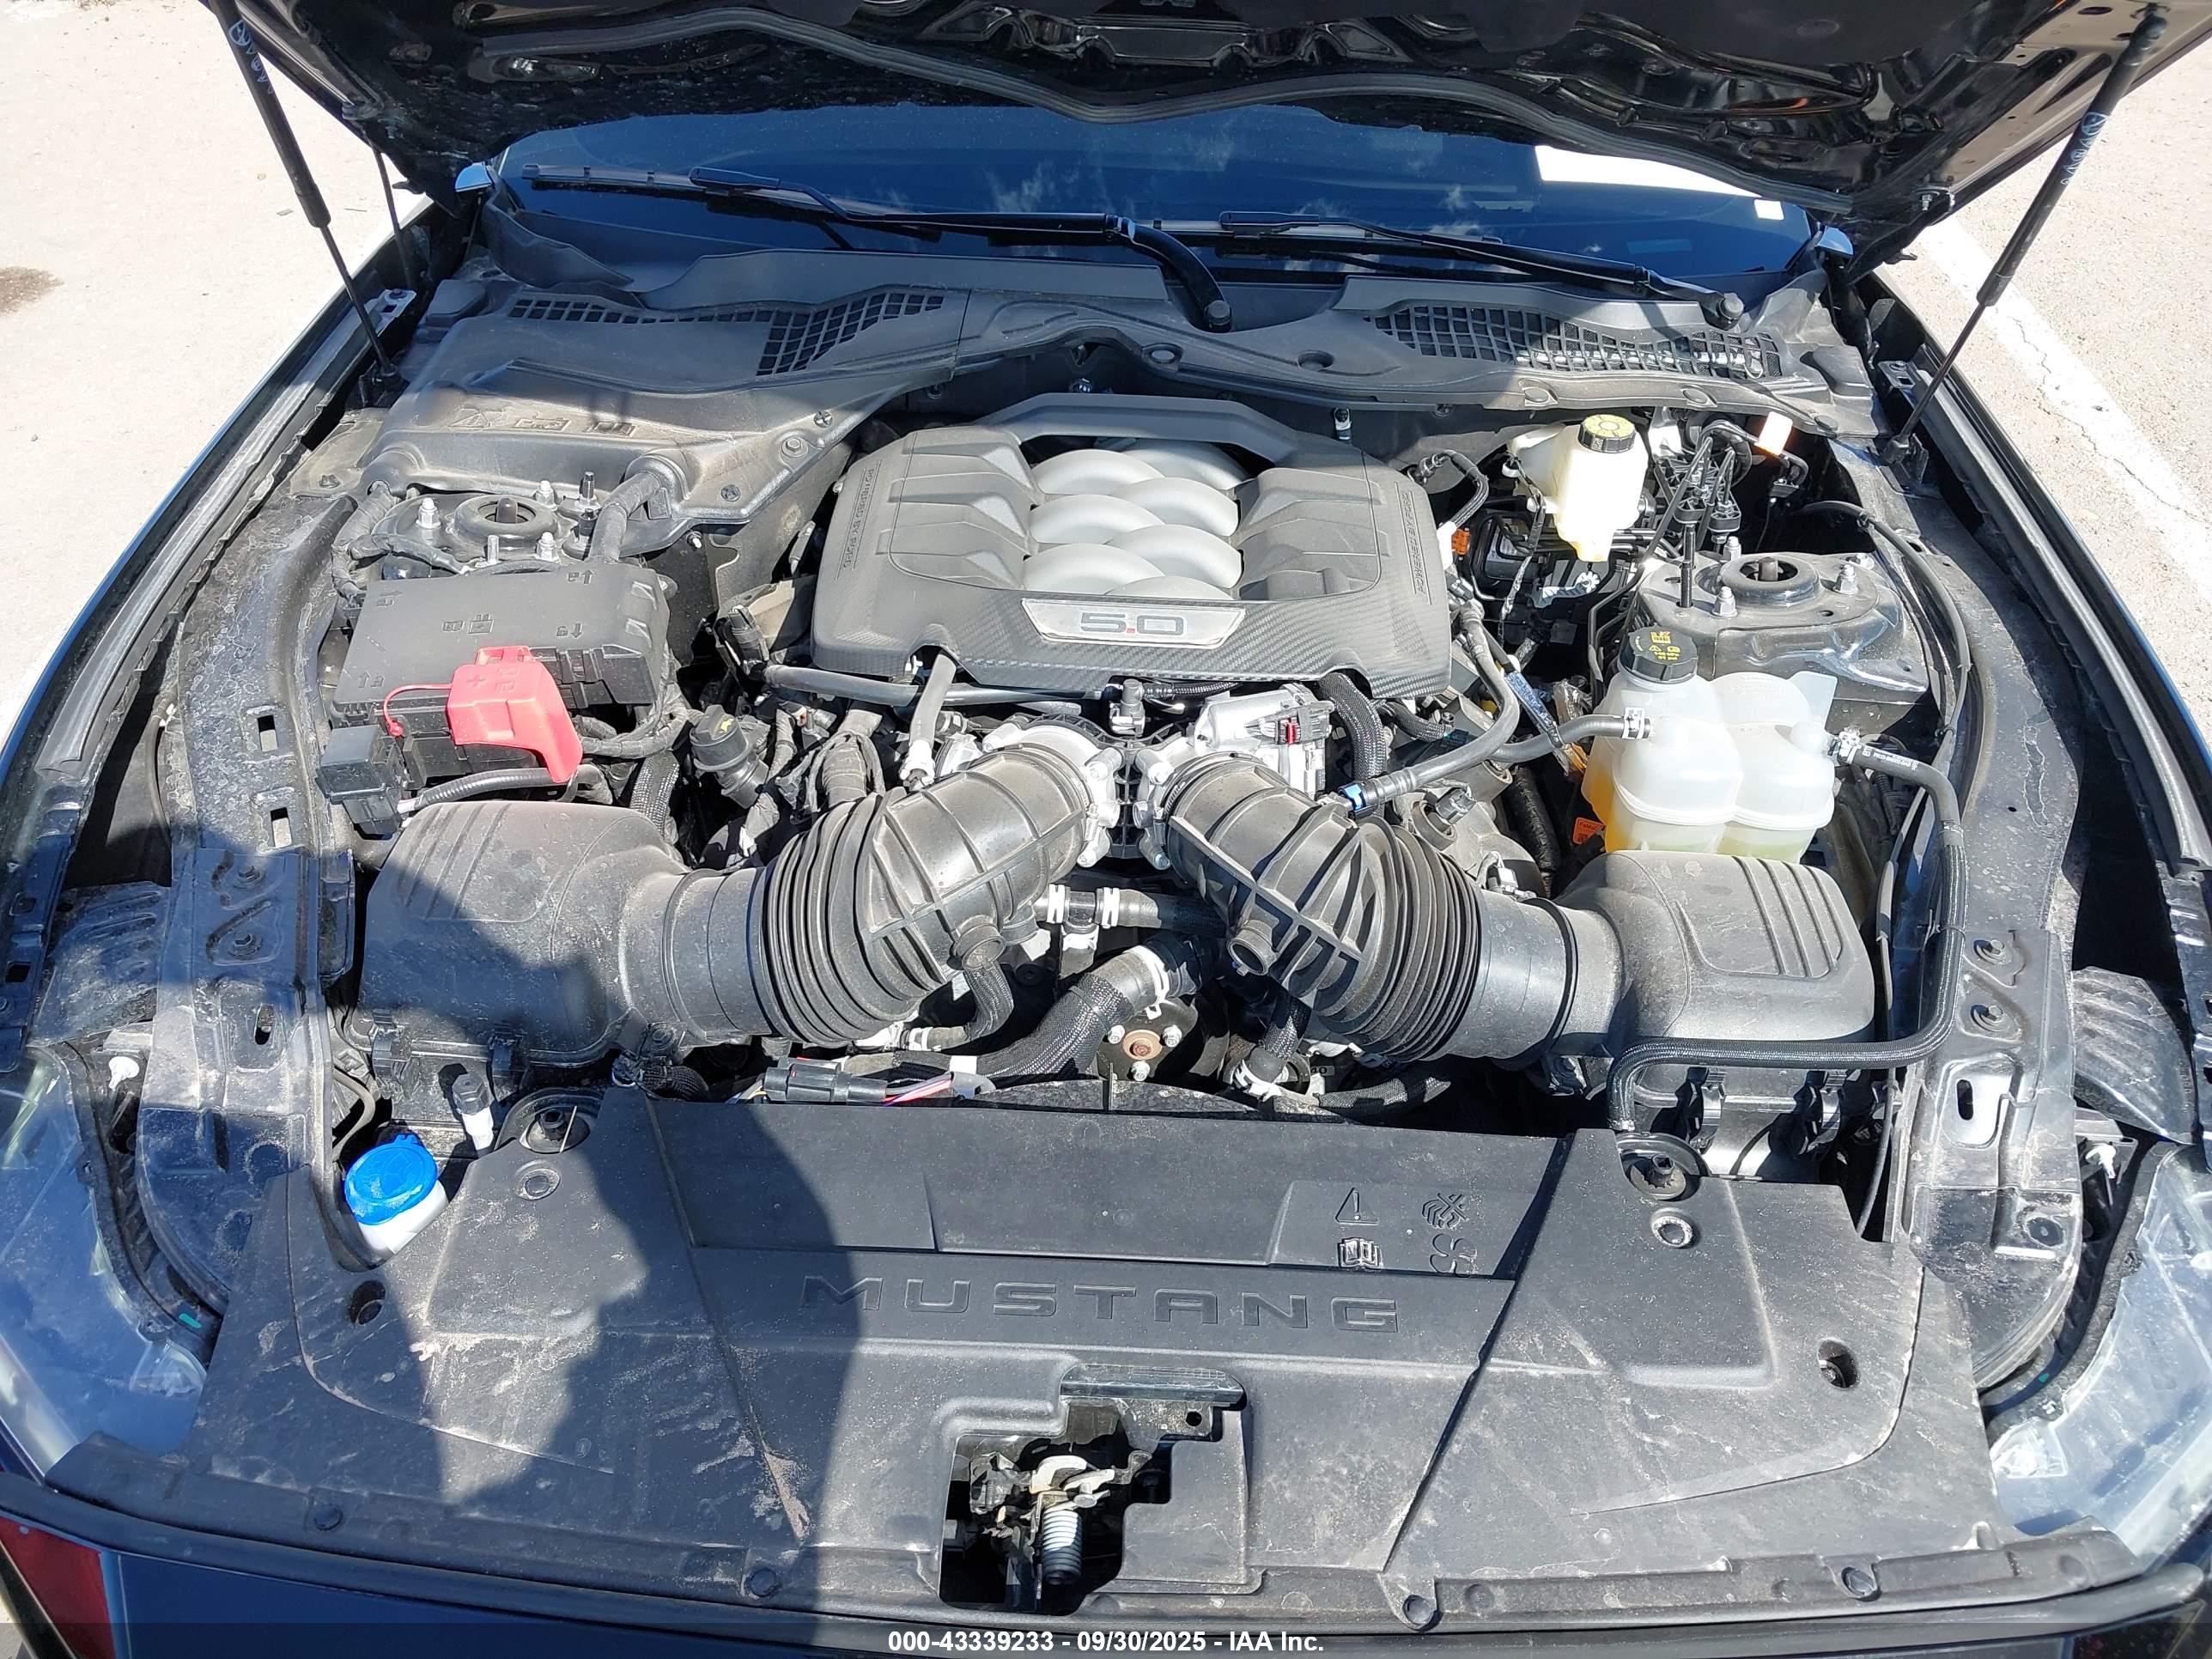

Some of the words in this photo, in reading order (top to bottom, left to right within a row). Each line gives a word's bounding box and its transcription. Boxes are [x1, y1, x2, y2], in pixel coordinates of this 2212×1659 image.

[1408, 538, 1426, 594] POWERED
[1080, 611, 1185, 635] 5.0
[802, 1276, 1399, 1333] MUSTANG
